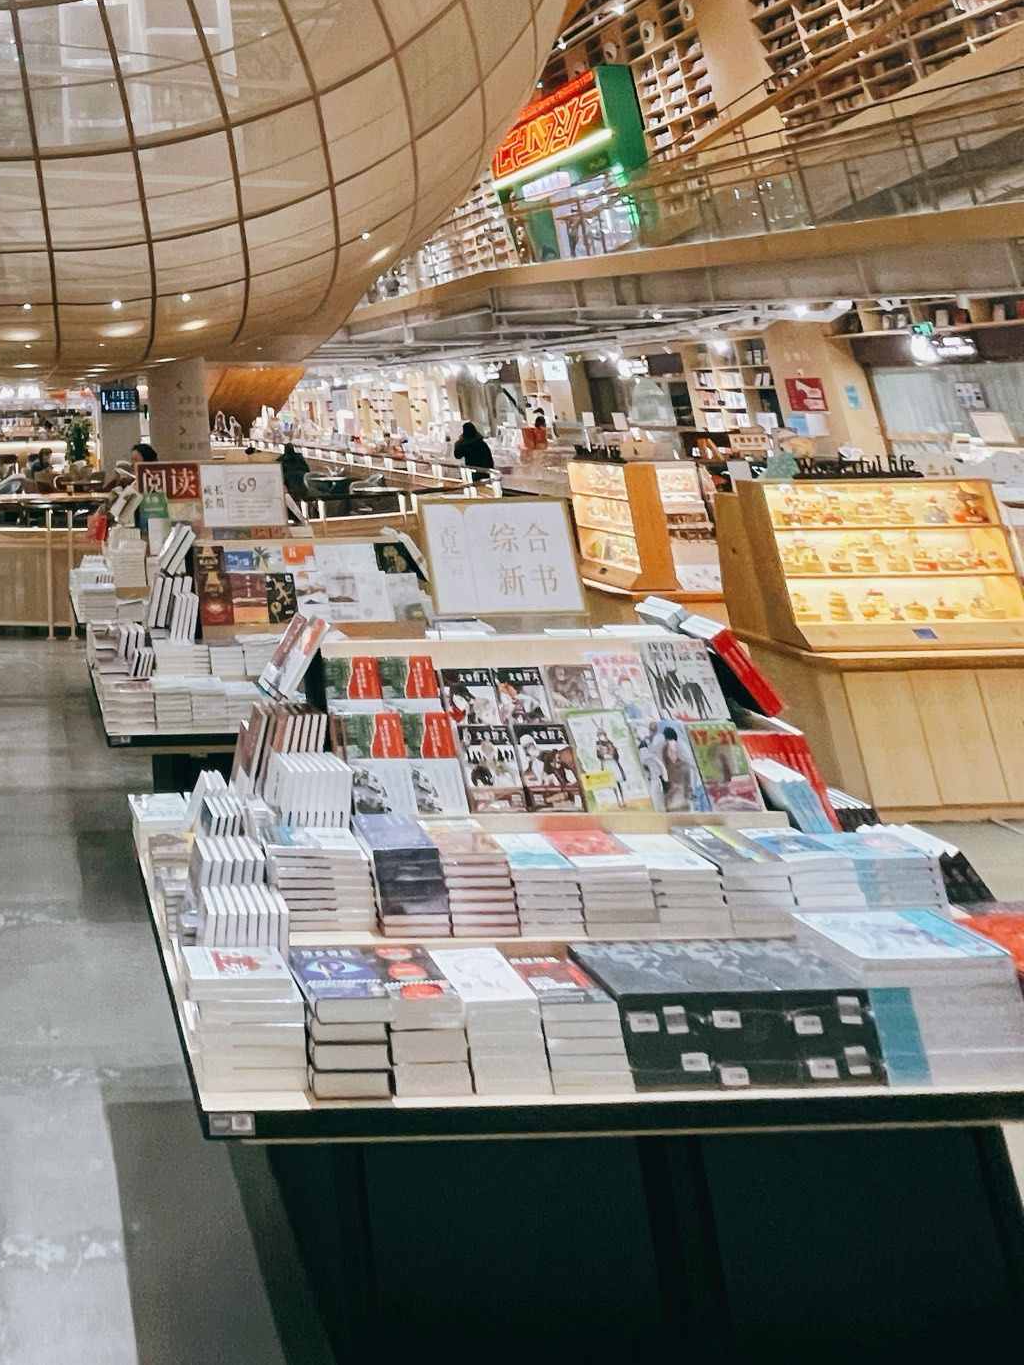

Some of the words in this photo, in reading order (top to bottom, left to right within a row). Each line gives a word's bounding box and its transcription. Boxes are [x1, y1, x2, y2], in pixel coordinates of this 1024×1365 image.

[142, 468, 199, 497] 阅读
[237, 477, 257, 493] 69
[490, 523, 550, 553] 综合
[498, 563, 558, 597] 新书
